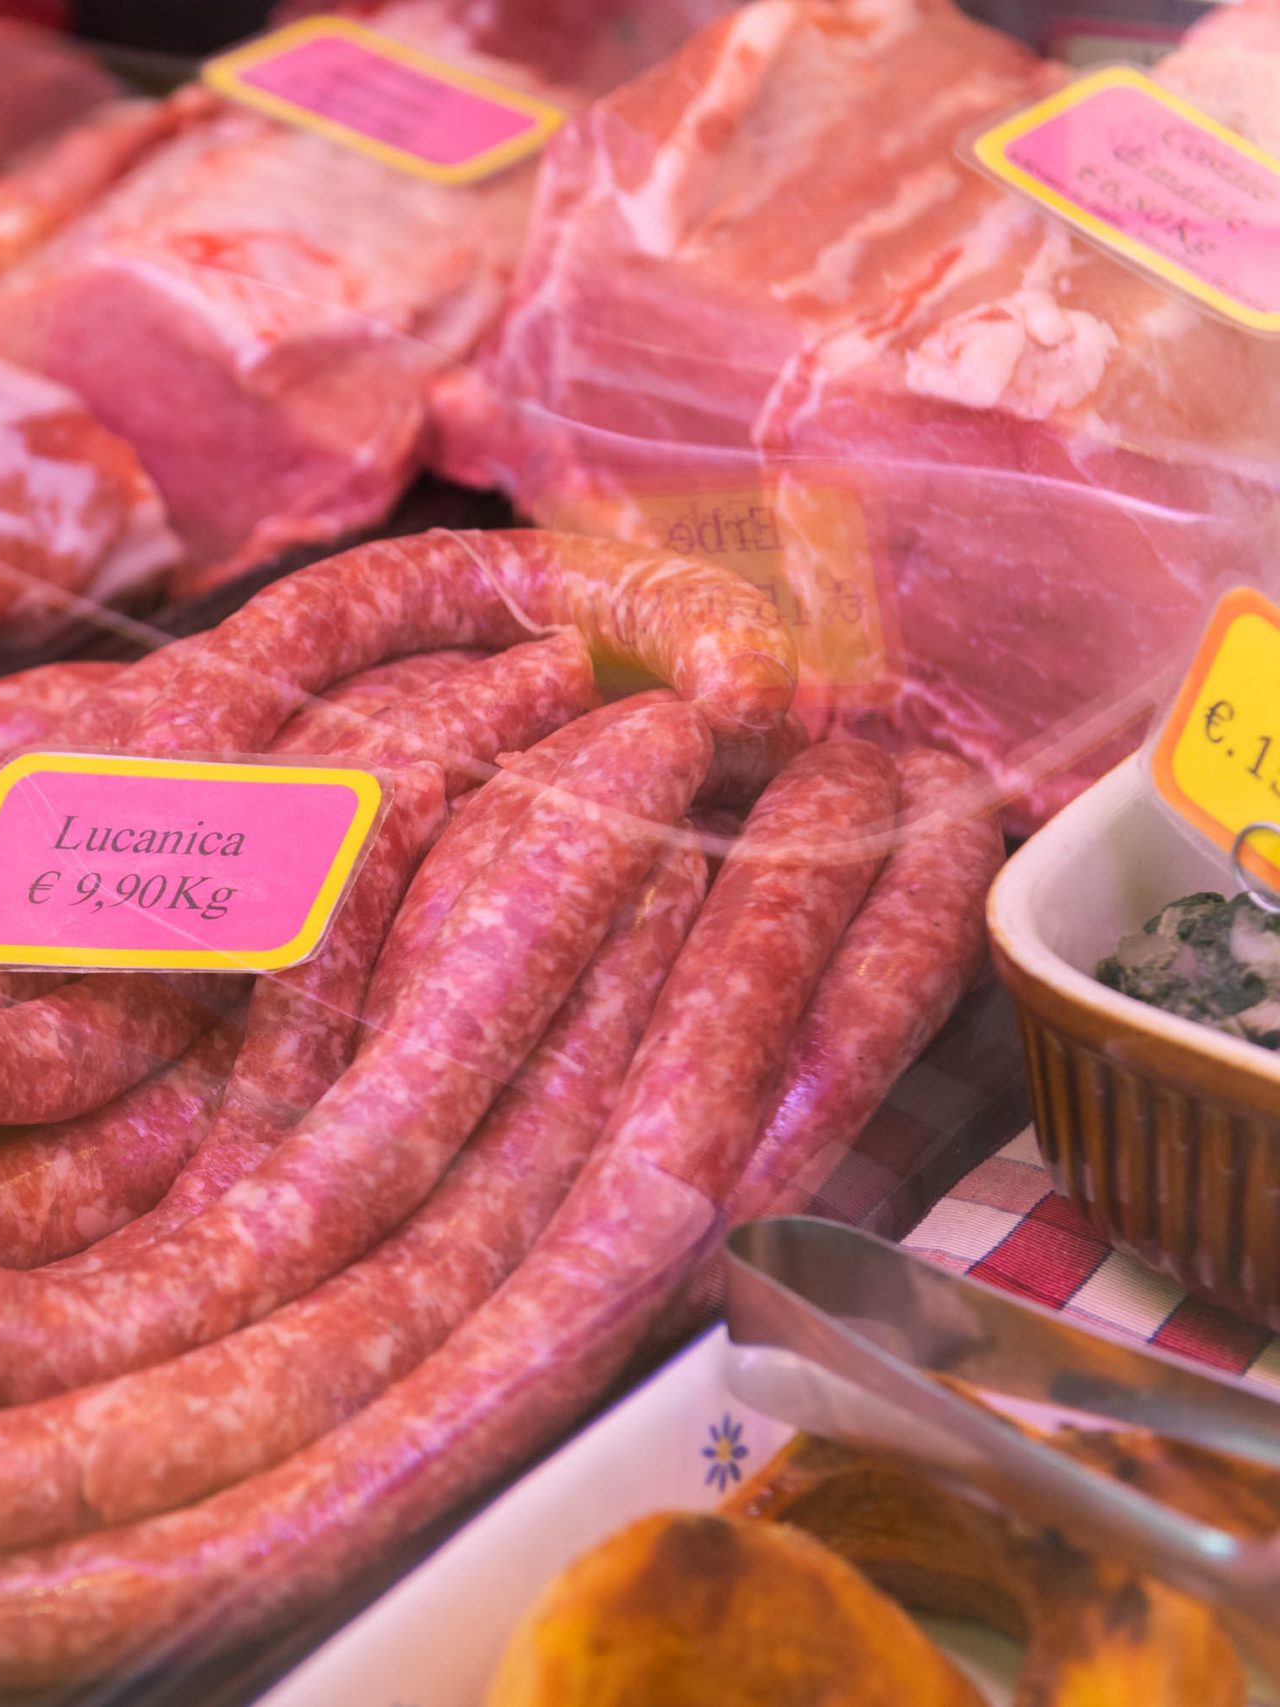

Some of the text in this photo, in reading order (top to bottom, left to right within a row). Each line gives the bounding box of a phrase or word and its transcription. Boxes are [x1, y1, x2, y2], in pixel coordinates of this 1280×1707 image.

[52, 814, 246, 857] Lucanica
[27, 870, 238, 921] € 9,90Kg
